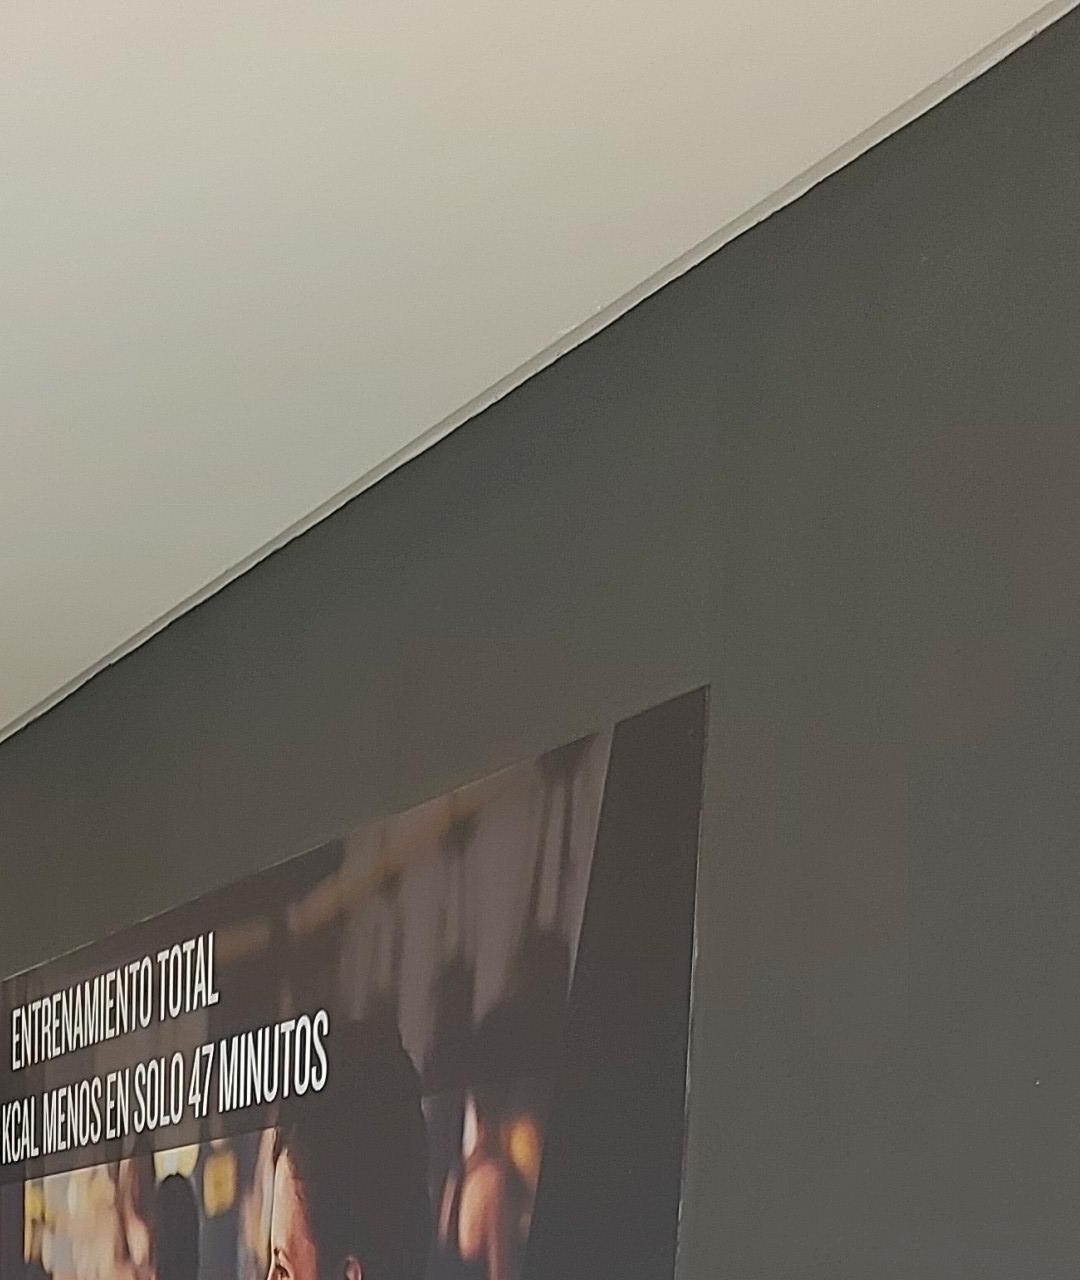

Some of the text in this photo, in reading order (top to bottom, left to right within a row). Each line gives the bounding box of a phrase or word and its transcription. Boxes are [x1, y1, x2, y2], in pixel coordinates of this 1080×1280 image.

[11, 931, 220, 1072] ENTRENAMIENTO TOTAL
[1, 1094, 40, 1165] KCAL
[42, 1076, 103, 1155] MENOS
[105, 1067, 130, 1141] EN
[133, 1051, 184, 1134] SOLO
[187, 1042, 215, 1119] 47
[218, 1009, 330, 1113] MINUTOS
